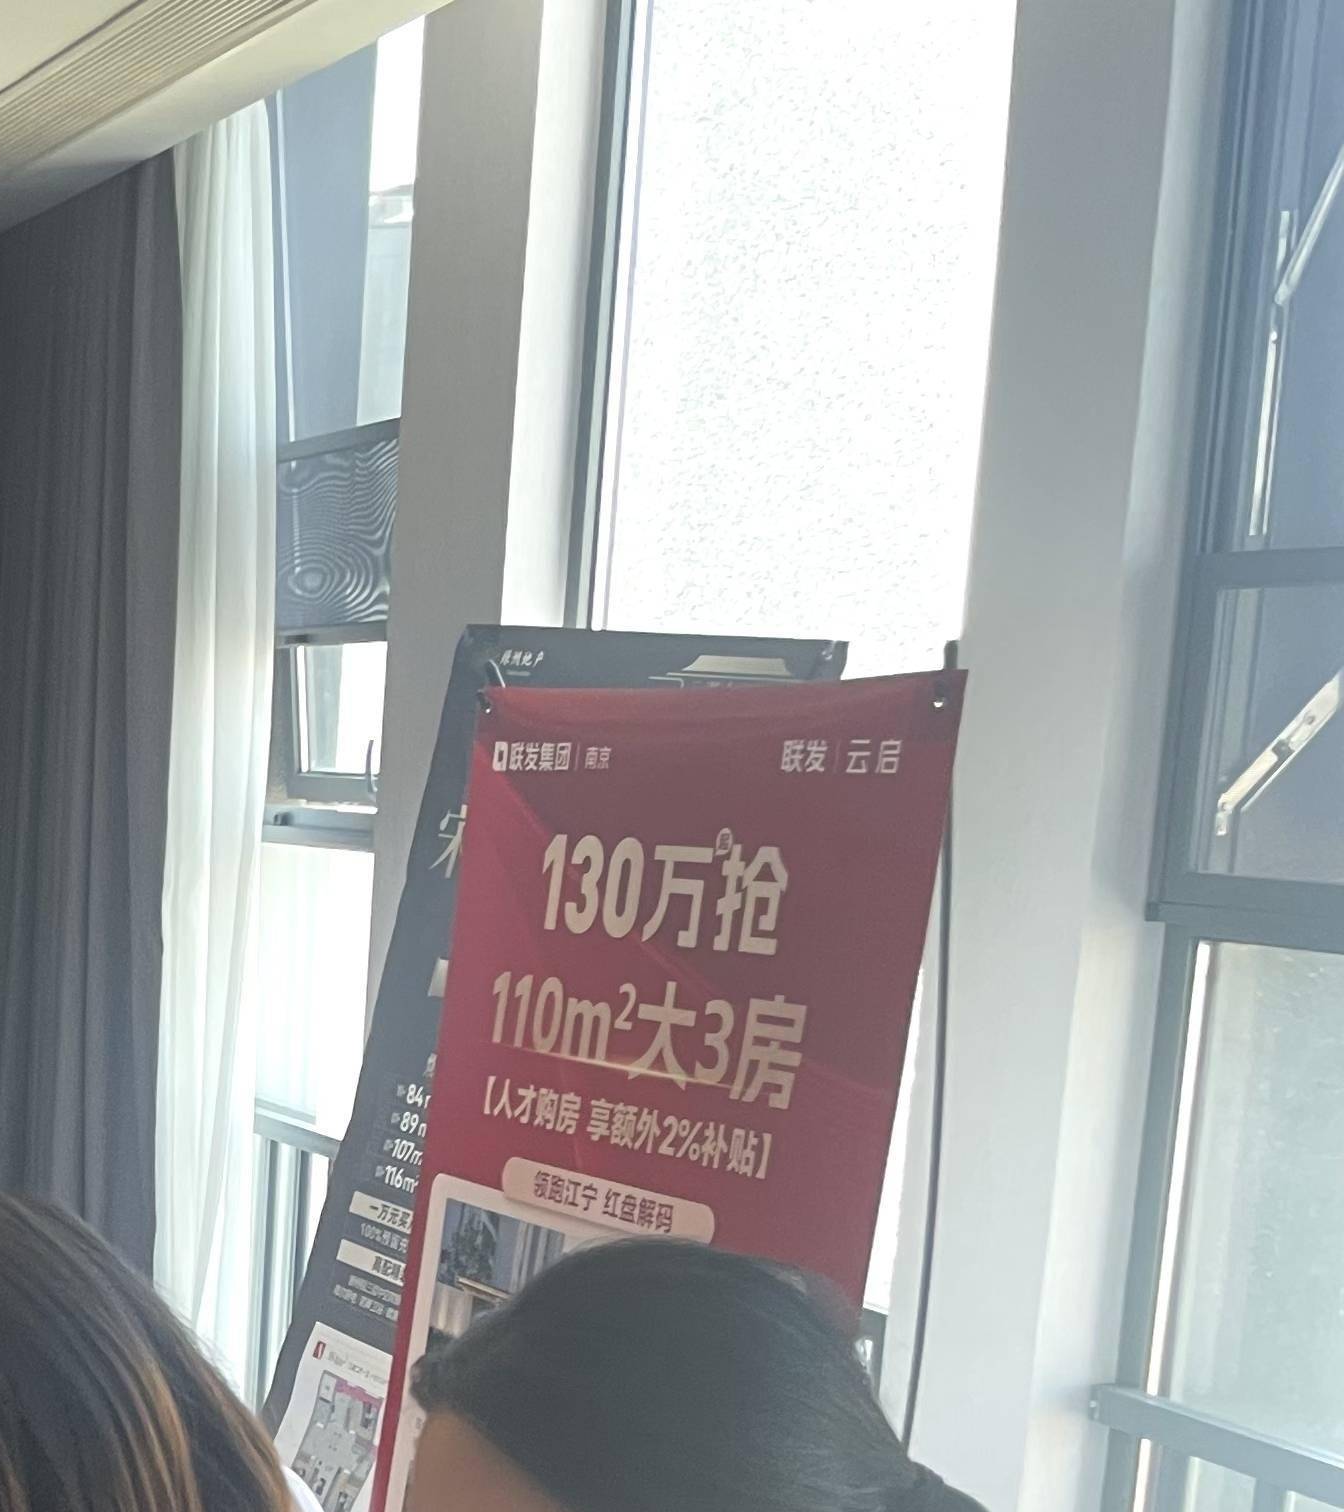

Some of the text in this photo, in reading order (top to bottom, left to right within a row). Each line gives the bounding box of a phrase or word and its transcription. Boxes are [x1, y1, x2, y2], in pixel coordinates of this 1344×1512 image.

[509, 742, 611, 771] 联发集团 南京
[781, 739, 903, 773] 联发 云启
[534, 1170, 674, 1233] 领跑江宁 红盘解码
